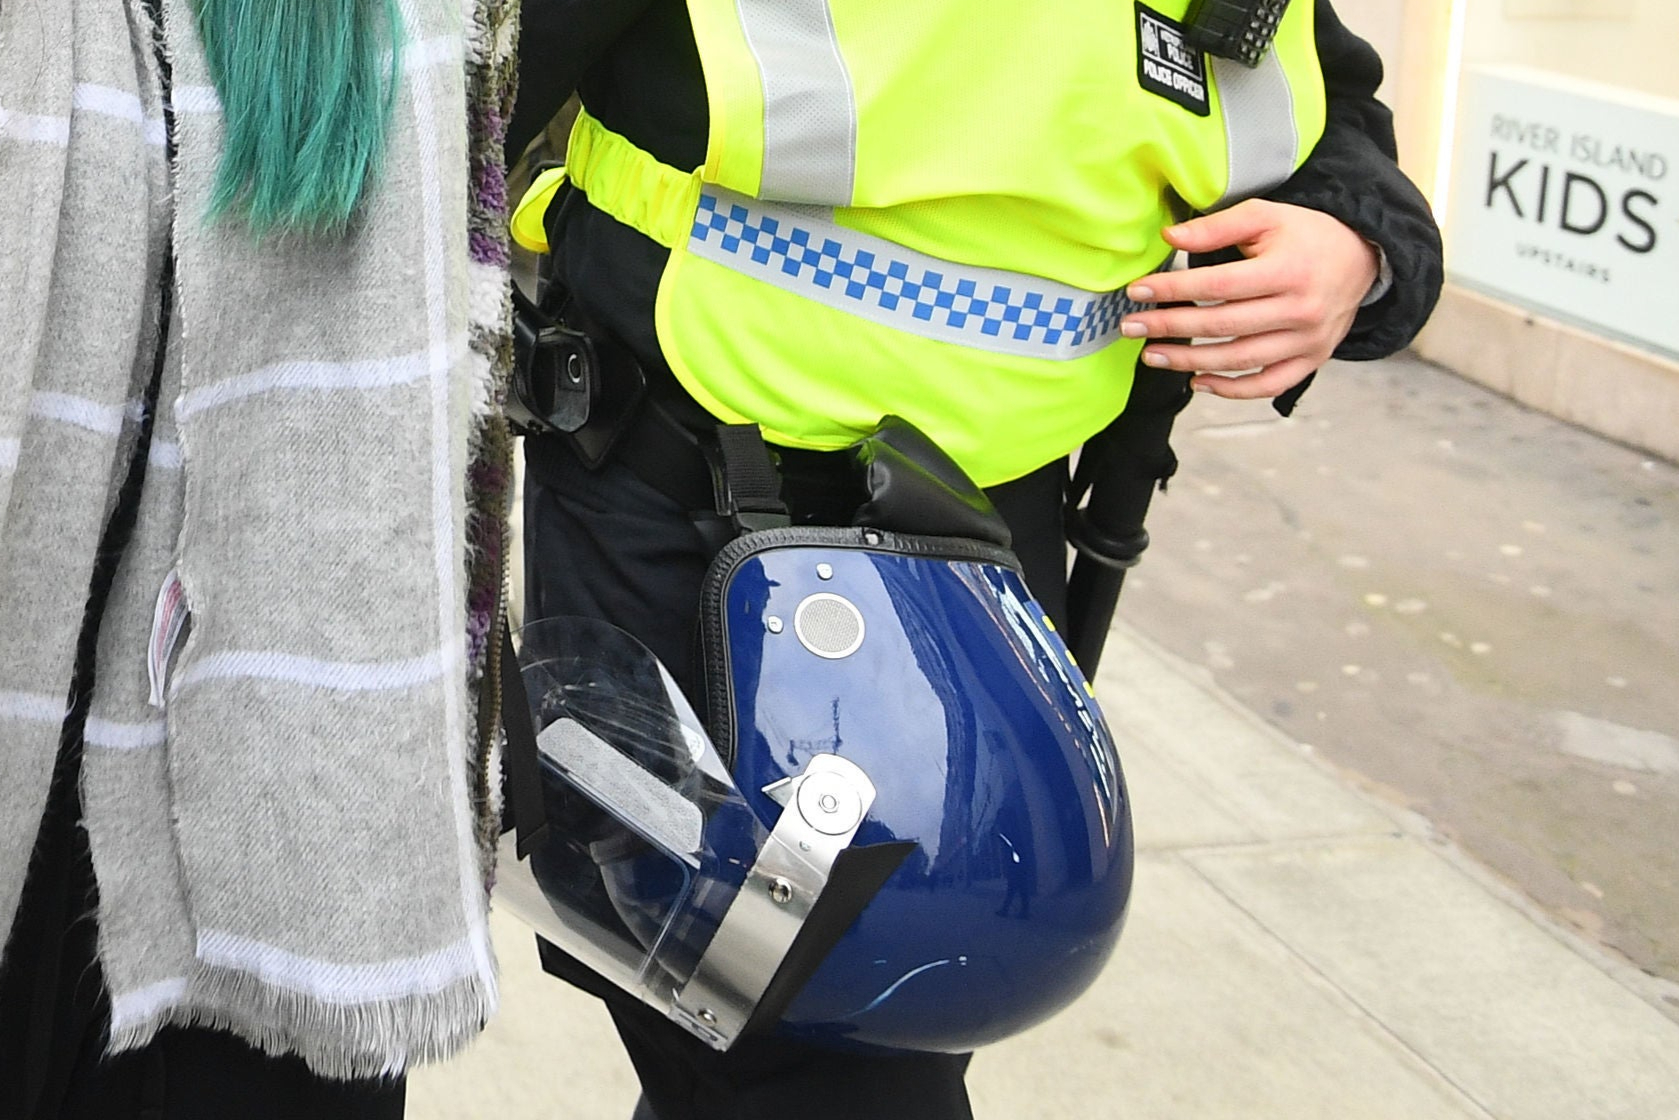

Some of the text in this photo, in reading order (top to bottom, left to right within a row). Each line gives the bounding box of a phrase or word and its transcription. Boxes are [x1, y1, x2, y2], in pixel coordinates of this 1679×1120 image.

[1143, 58, 1205, 102] POLICE OFFICER
[1491, 113, 1669, 181] RIVER ISLAND
[1485, 151, 1659, 254] KIDS
[1515, 242, 1610, 284] UPSTAIRS
